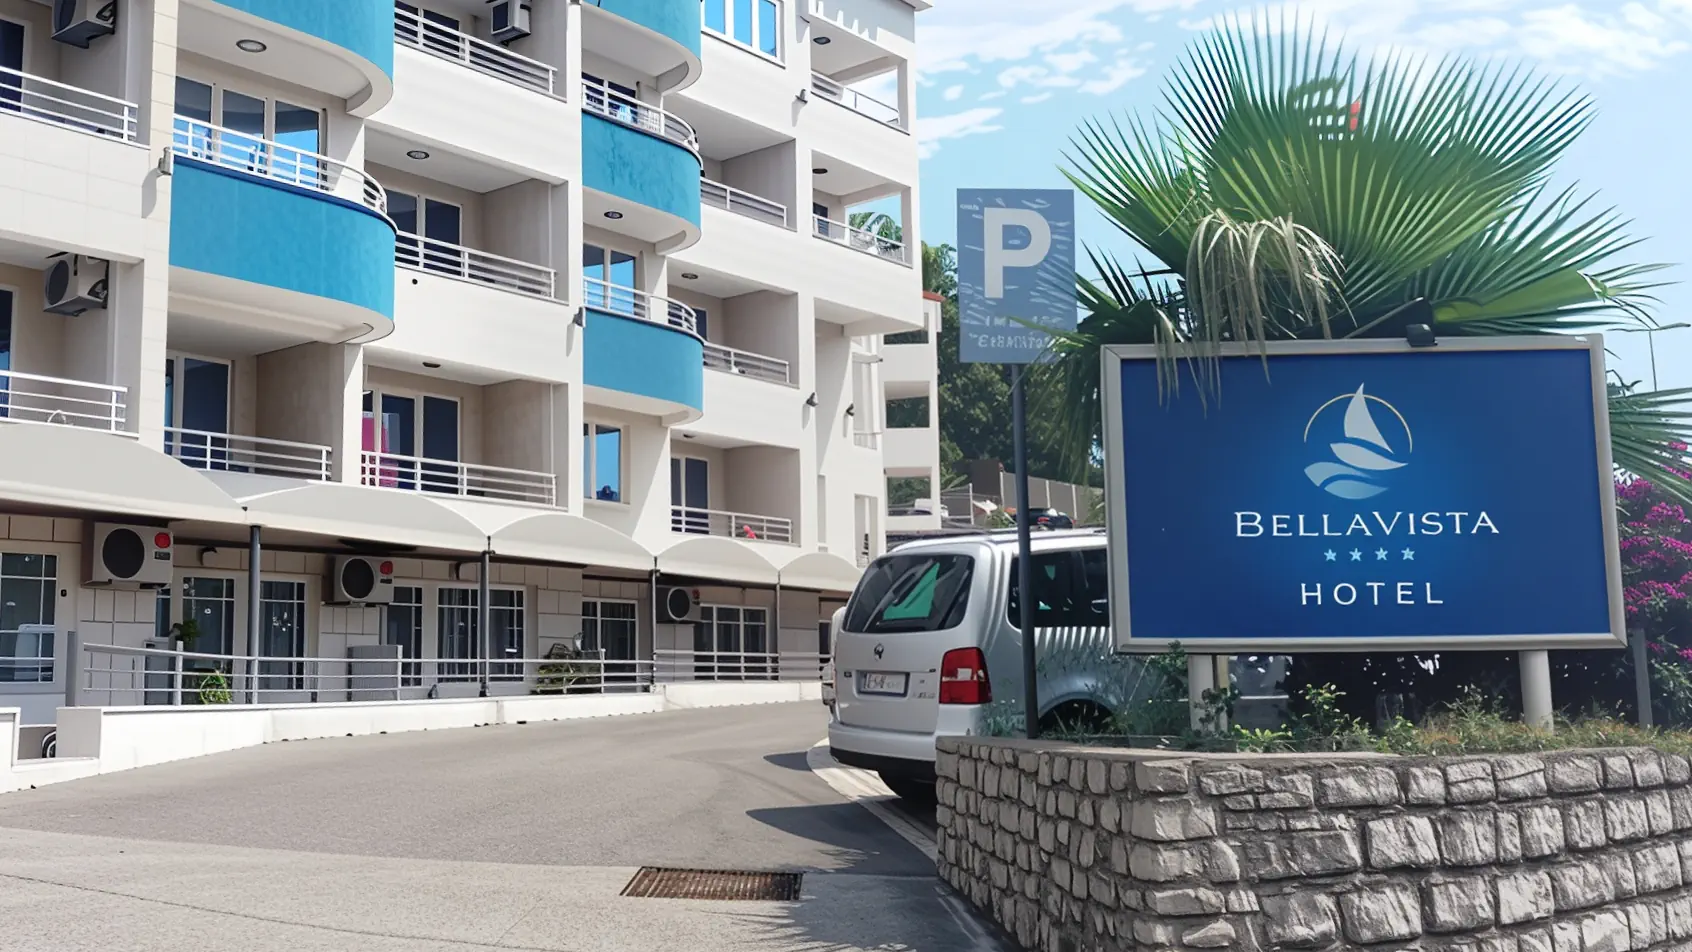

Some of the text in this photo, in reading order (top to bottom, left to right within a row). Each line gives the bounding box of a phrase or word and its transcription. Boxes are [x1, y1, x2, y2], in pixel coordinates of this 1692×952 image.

[984, 207, 1051, 299] P
[1234, 511, 1500, 537] BELLAVISTA
[1300, 582, 1444, 606] HOTEL
